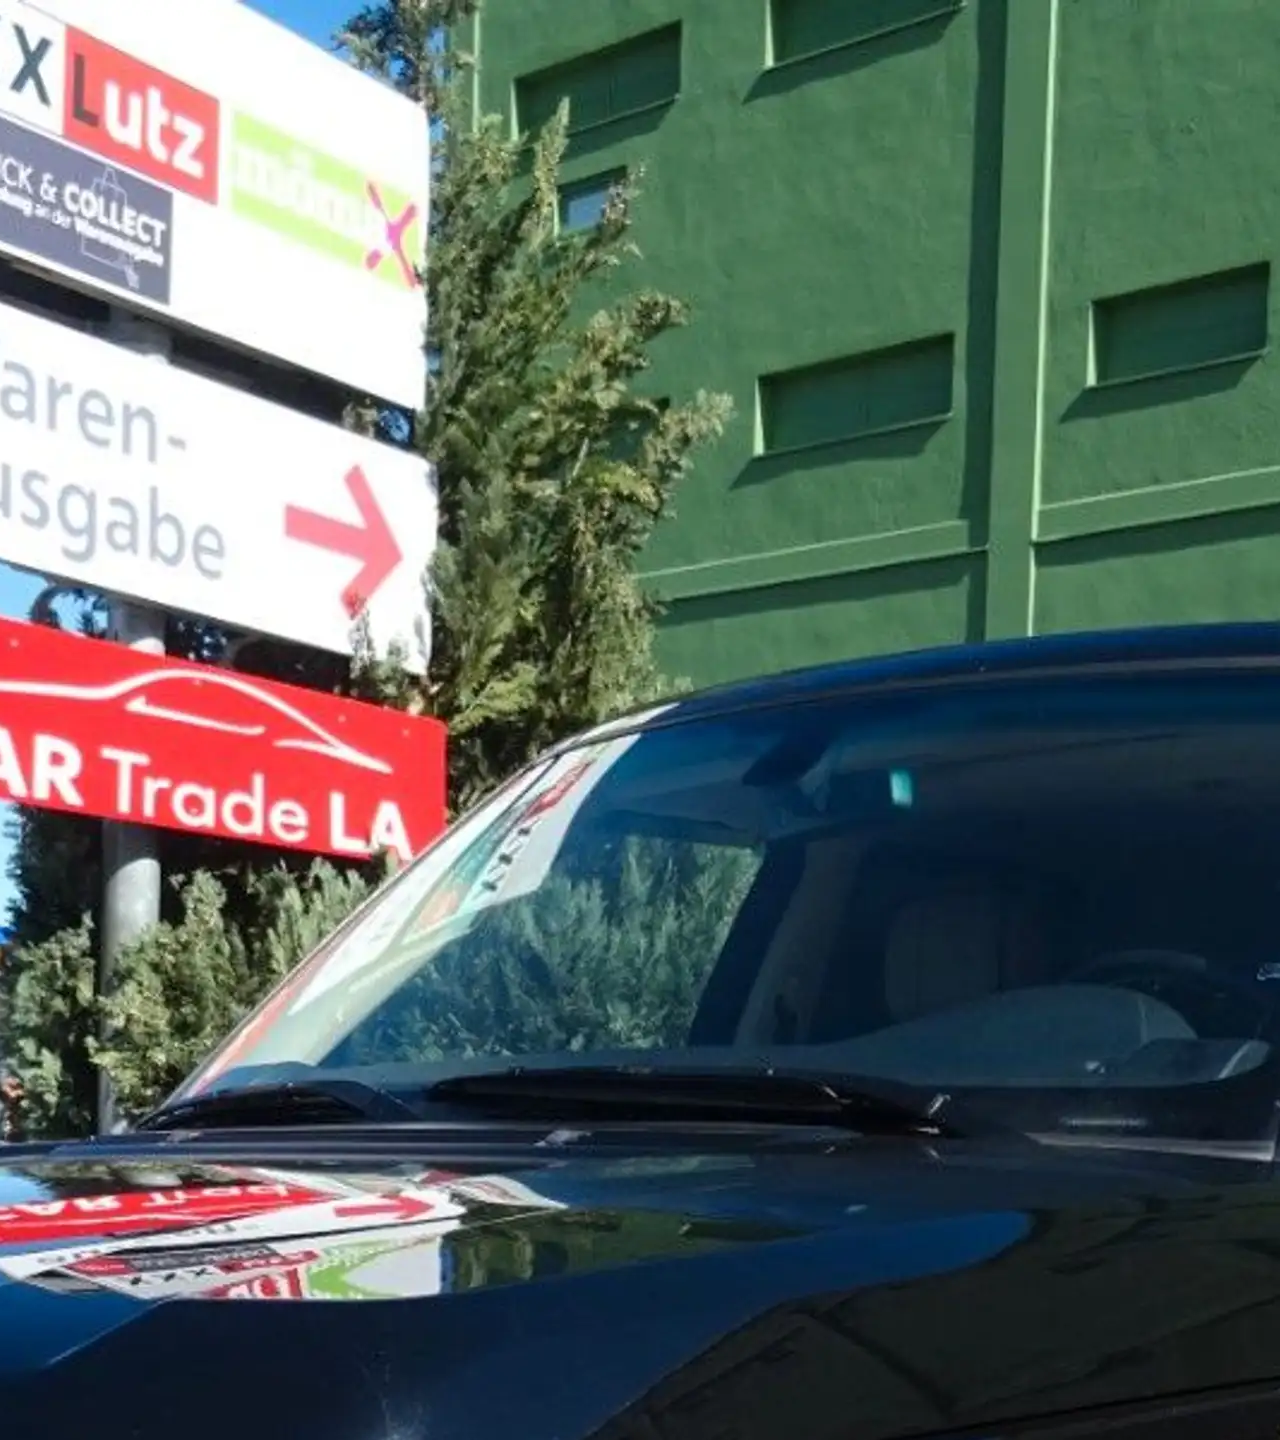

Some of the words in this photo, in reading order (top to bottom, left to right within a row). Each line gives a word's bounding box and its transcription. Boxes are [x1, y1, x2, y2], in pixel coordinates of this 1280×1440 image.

[40, 173, 57, 203] &
[64, 183, 167, 247] COLLECT
[100, 747, 309, 843] Trade
[330, 792, 413, 862] LA
